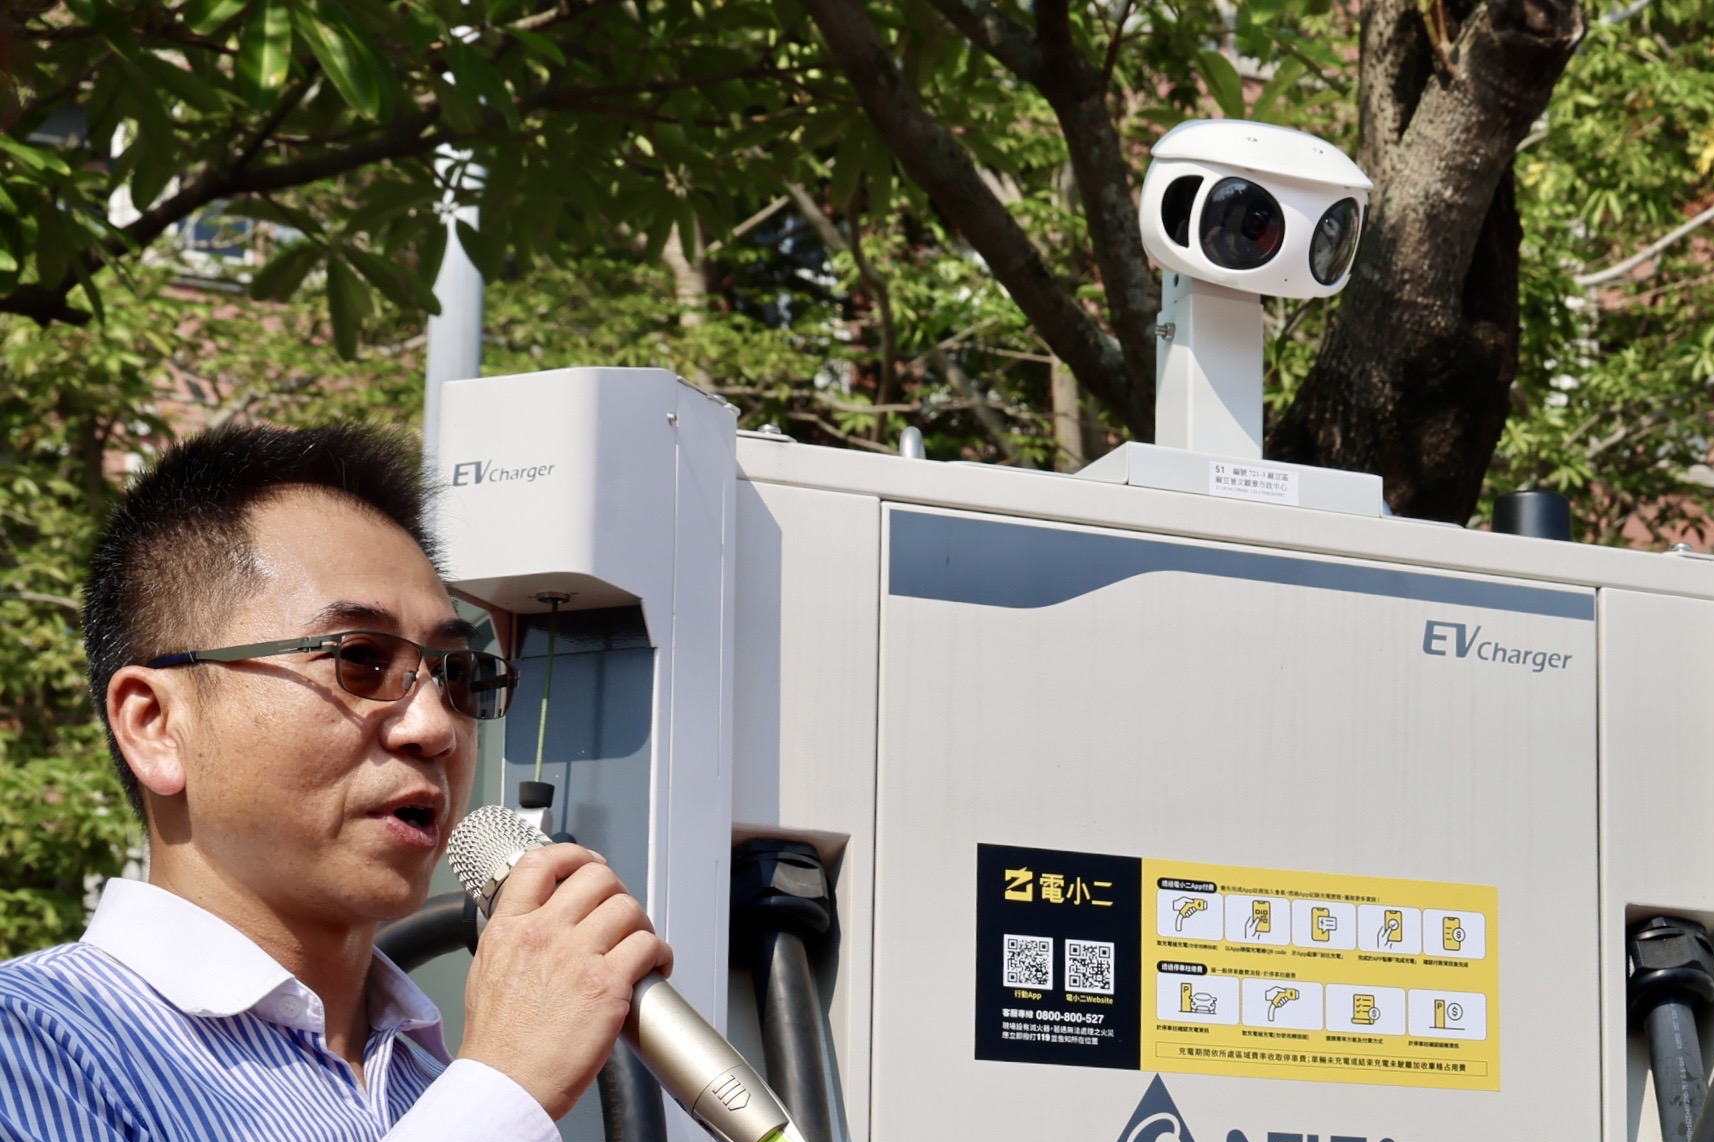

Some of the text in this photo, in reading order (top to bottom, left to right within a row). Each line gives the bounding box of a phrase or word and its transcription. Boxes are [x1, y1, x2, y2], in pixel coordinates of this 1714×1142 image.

[452, 459, 555, 487] EV Charger
[1215, 465, 1225, 474] 51
[1422, 620, 1572, 673] EV Charger
[1039, 873, 1114, 906] 電小二
[1014, 989, 1042, 1000] 行動App
[1065, 993, 1114, 1005] 電小二Website
[1002, 1008, 1105, 1024] 客服專線 0800-800-527
